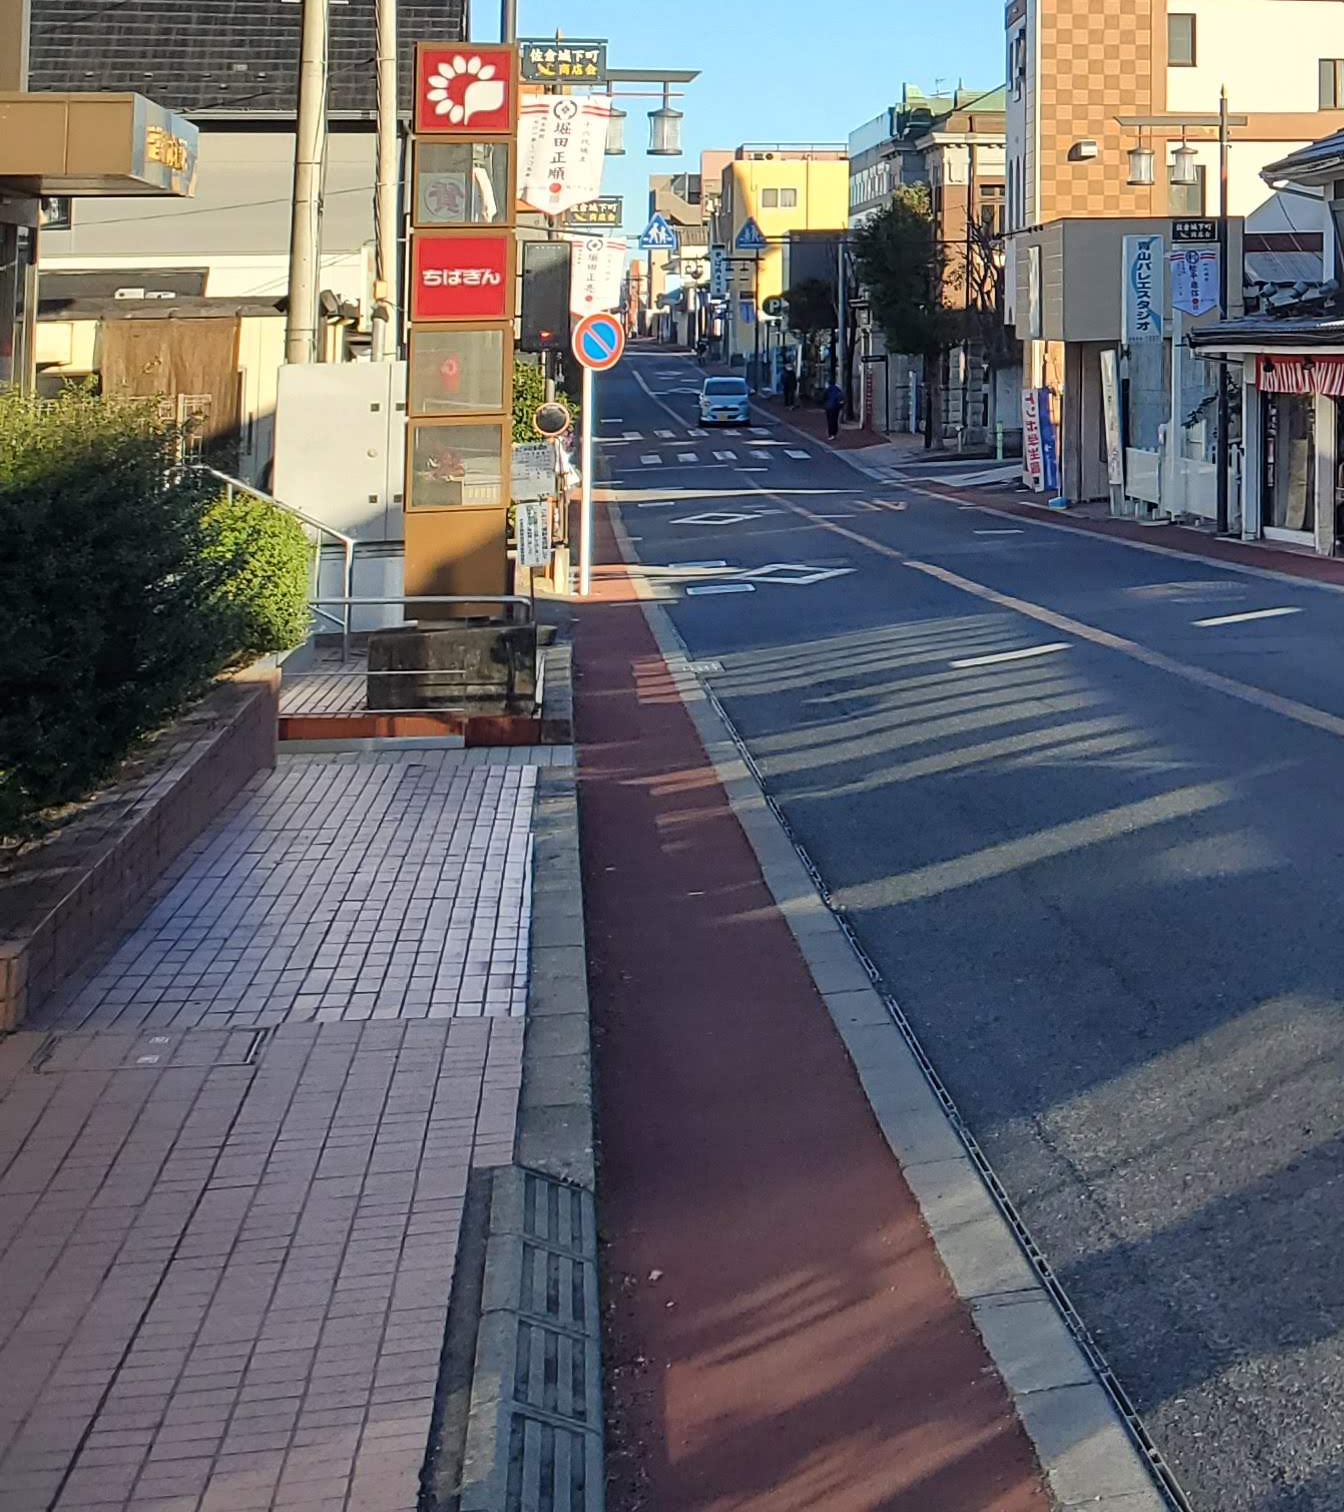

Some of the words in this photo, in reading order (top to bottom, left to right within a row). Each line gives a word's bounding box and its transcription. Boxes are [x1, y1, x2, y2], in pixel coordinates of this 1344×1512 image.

[529, 48, 600, 63] 佐倉城下町
[559, 64, 597, 76] 商店会
[548, 121, 571, 180] 堀田正順
[422, 268, 501, 286] ちばぎん
